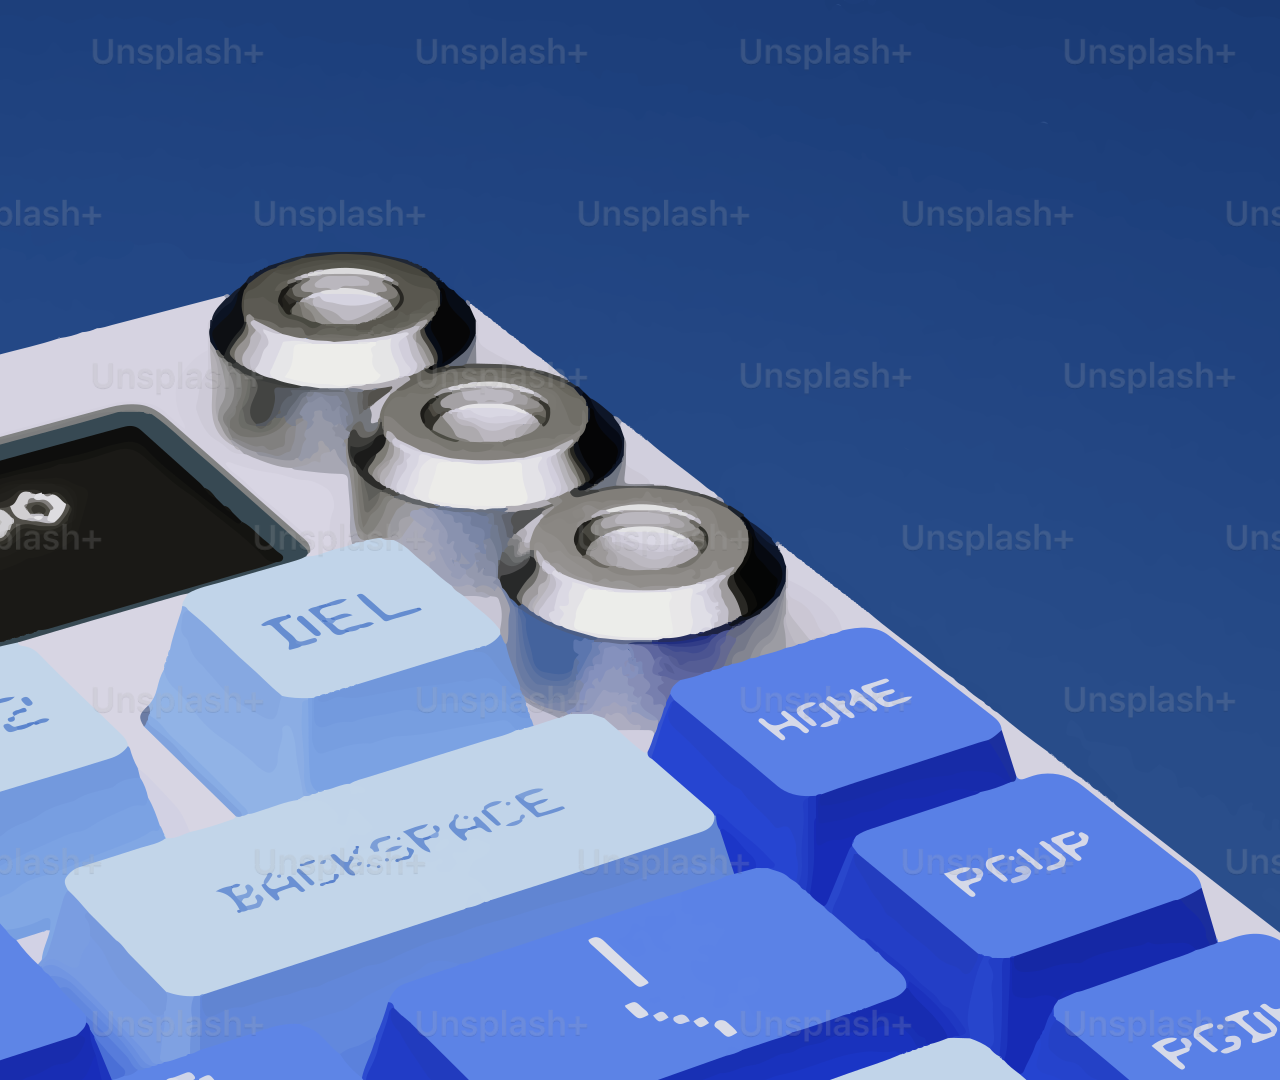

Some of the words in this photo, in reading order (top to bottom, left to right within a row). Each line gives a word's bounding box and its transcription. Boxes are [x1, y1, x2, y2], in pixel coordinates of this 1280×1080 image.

[261, 593, 422, 650] DEL
[758, 677, 913, 741] HOME
[216, 787, 566, 914] BACKSPACE
[944, 830, 1090, 898] PGUP
